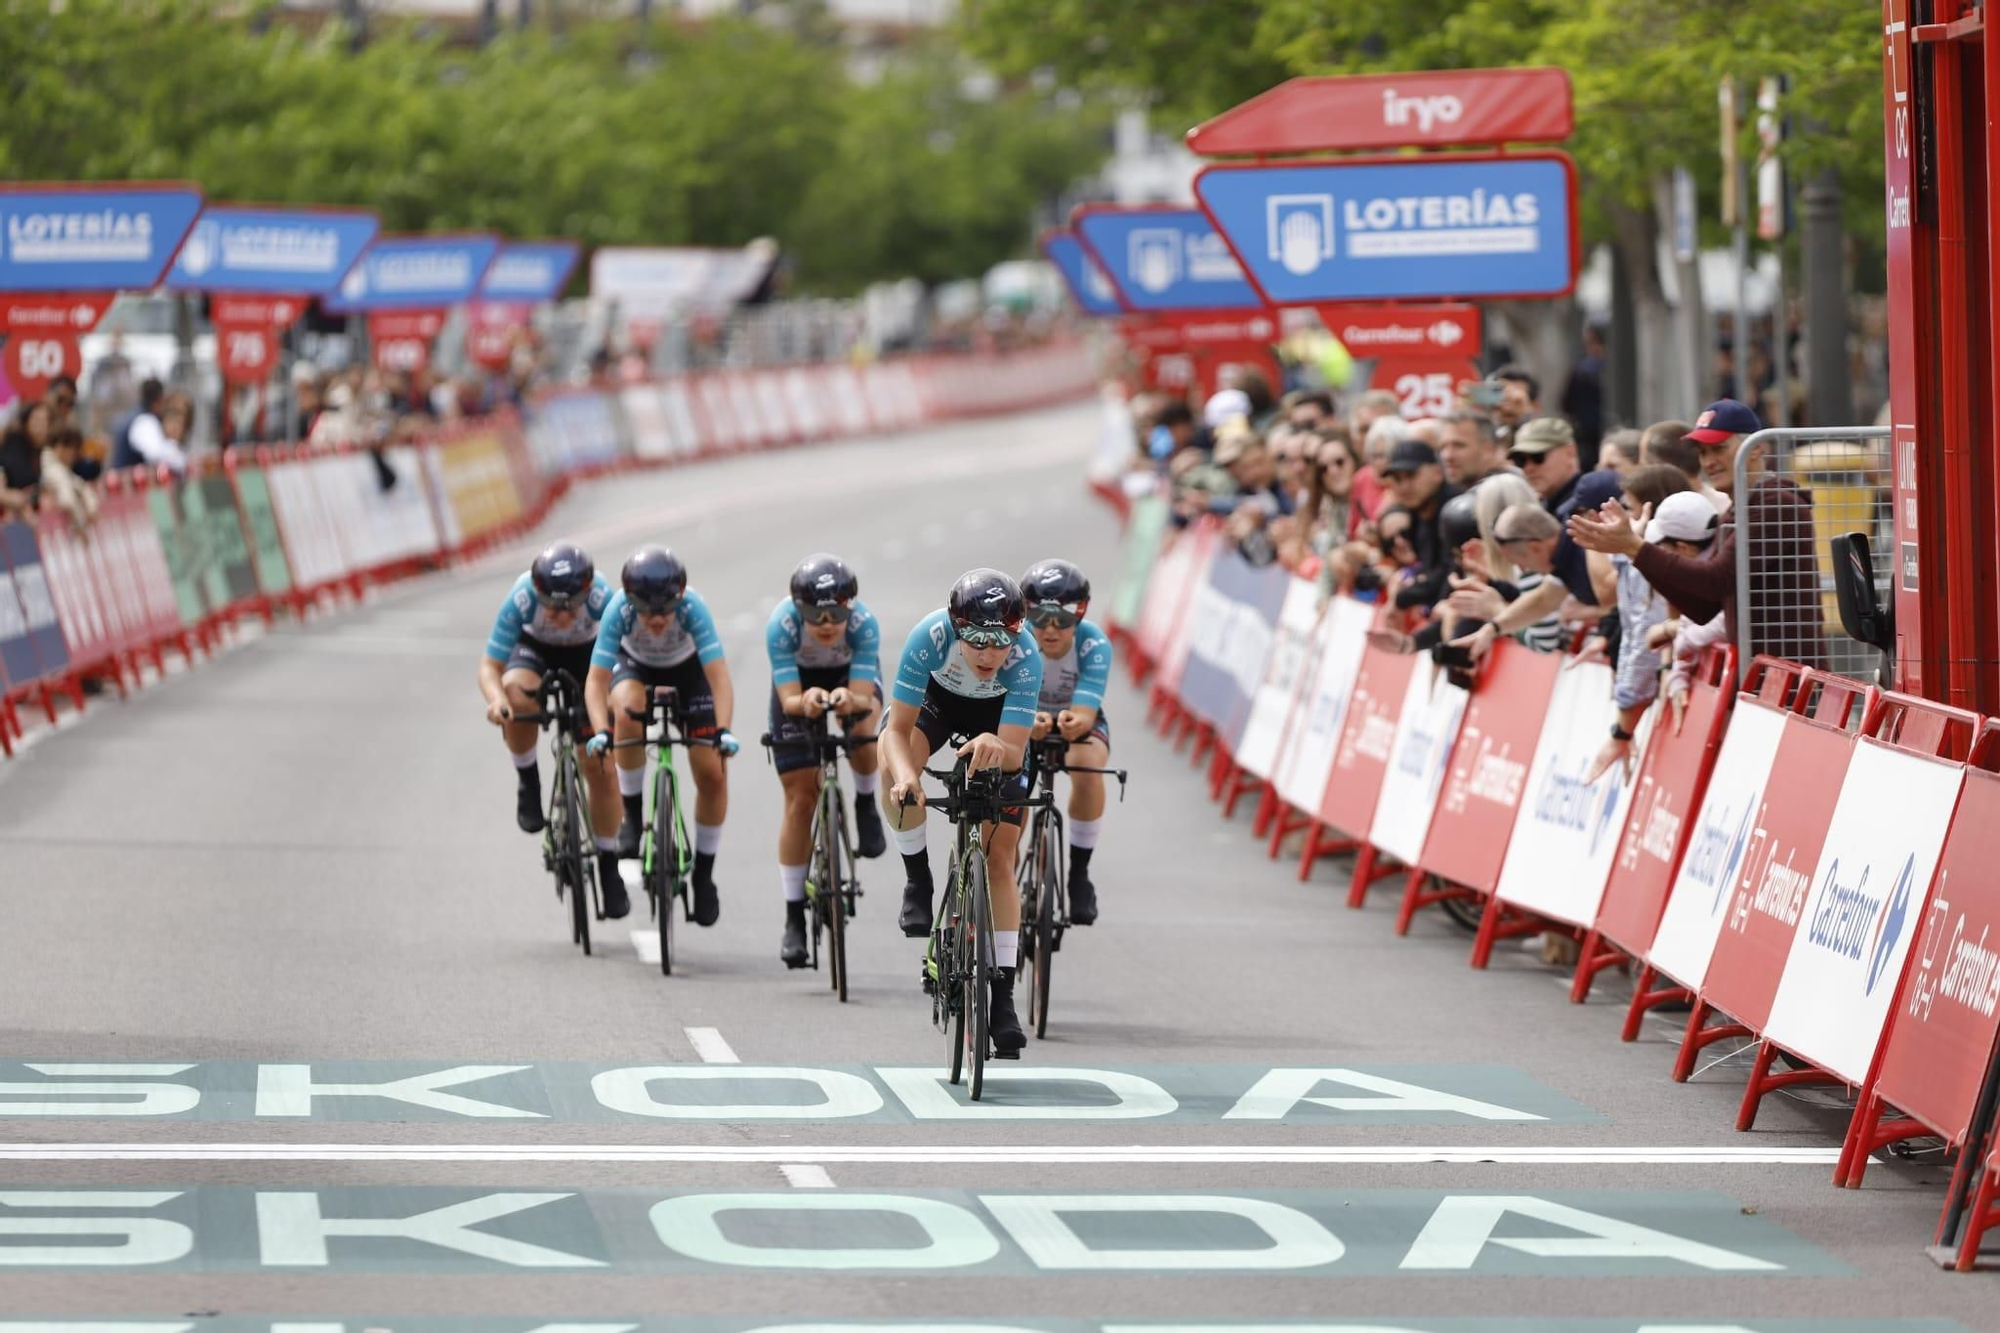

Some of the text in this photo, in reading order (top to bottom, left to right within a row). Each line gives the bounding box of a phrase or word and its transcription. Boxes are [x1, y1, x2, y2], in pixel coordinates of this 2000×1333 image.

[1383, 88, 1462, 133] iryo
[8, 208, 153, 240] LOTERÍAS
[1344, 189, 1540, 230] LOTERÍAS
[1343, 325, 1424, 344] Carrefour
[19, 338, 64, 379] 50
[1395, 373, 1453, 417] 25
[1808, 857, 1880, 961] Carrefour
